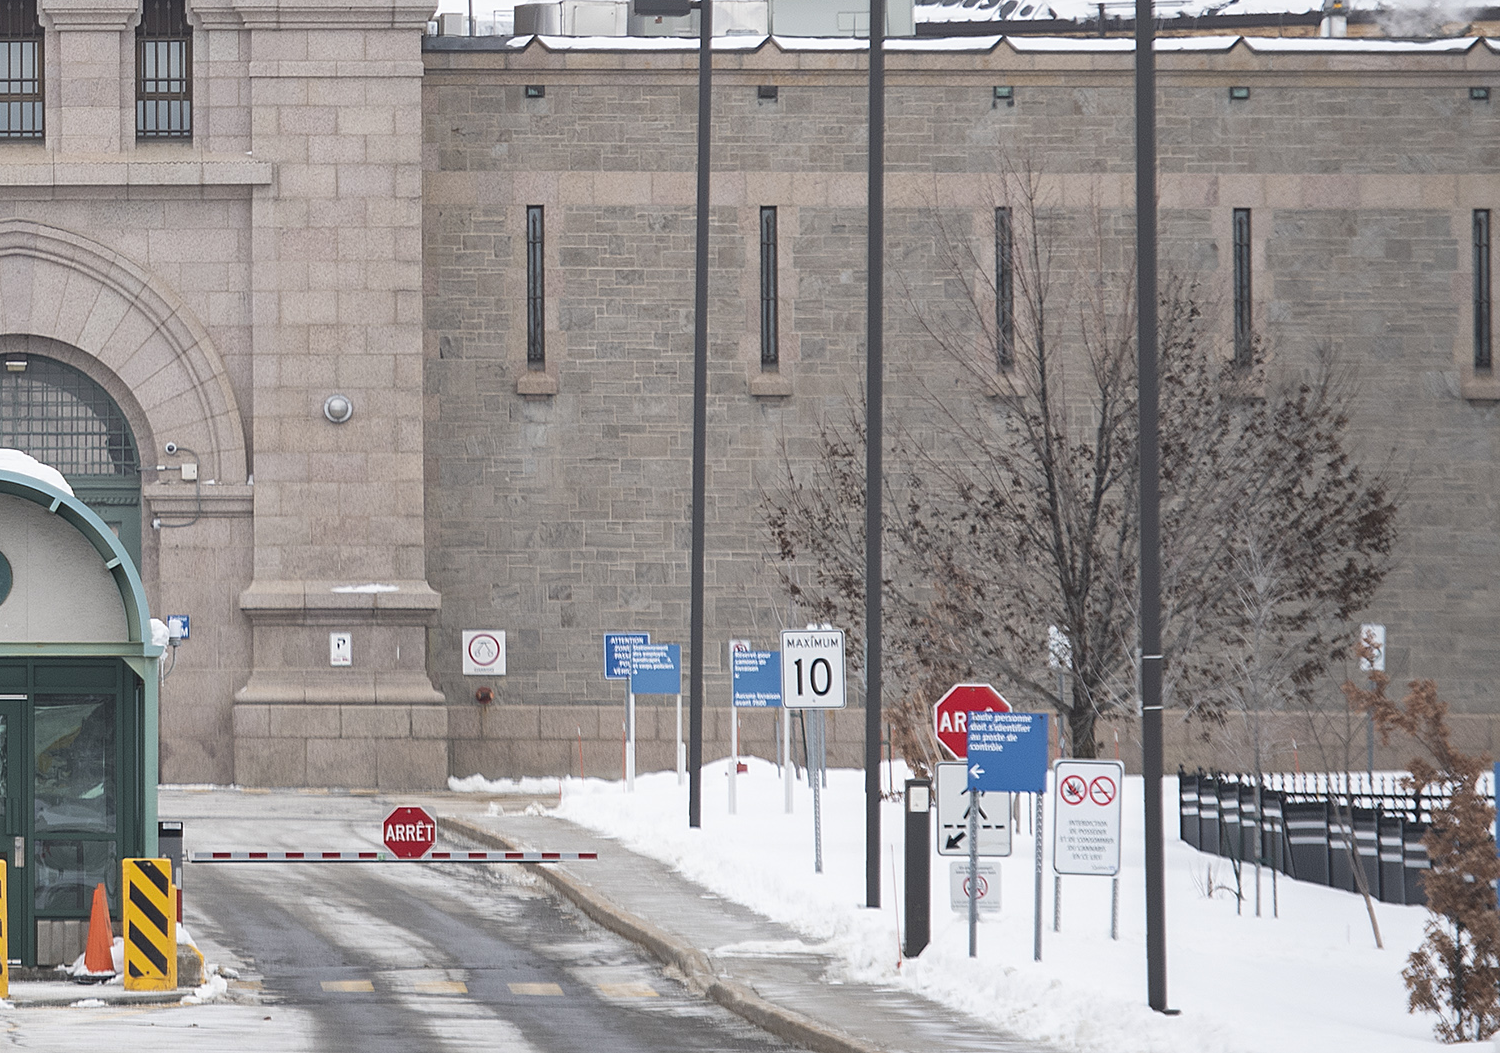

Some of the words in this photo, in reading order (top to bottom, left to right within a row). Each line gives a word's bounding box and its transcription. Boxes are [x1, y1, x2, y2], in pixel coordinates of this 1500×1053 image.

[610, 636, 644, 645] ATTENTION
[787, 638, 838, 648] MAXIMUM
[758, 652, 771, 660] pour
[794, 657, 833, 697] 10
[970, 712, 993, 721] Toute
[994, 714, 1033, 724] personne
[969, 722, 987, 732] doit
[969, 733, 981, 741] au
[982, 733, 1006, 743] poste
[1006, 733, 1018, 742] de
[969, 742, 1004, 752] contrôle
[385, 820, 434, 842] ARRÊT
